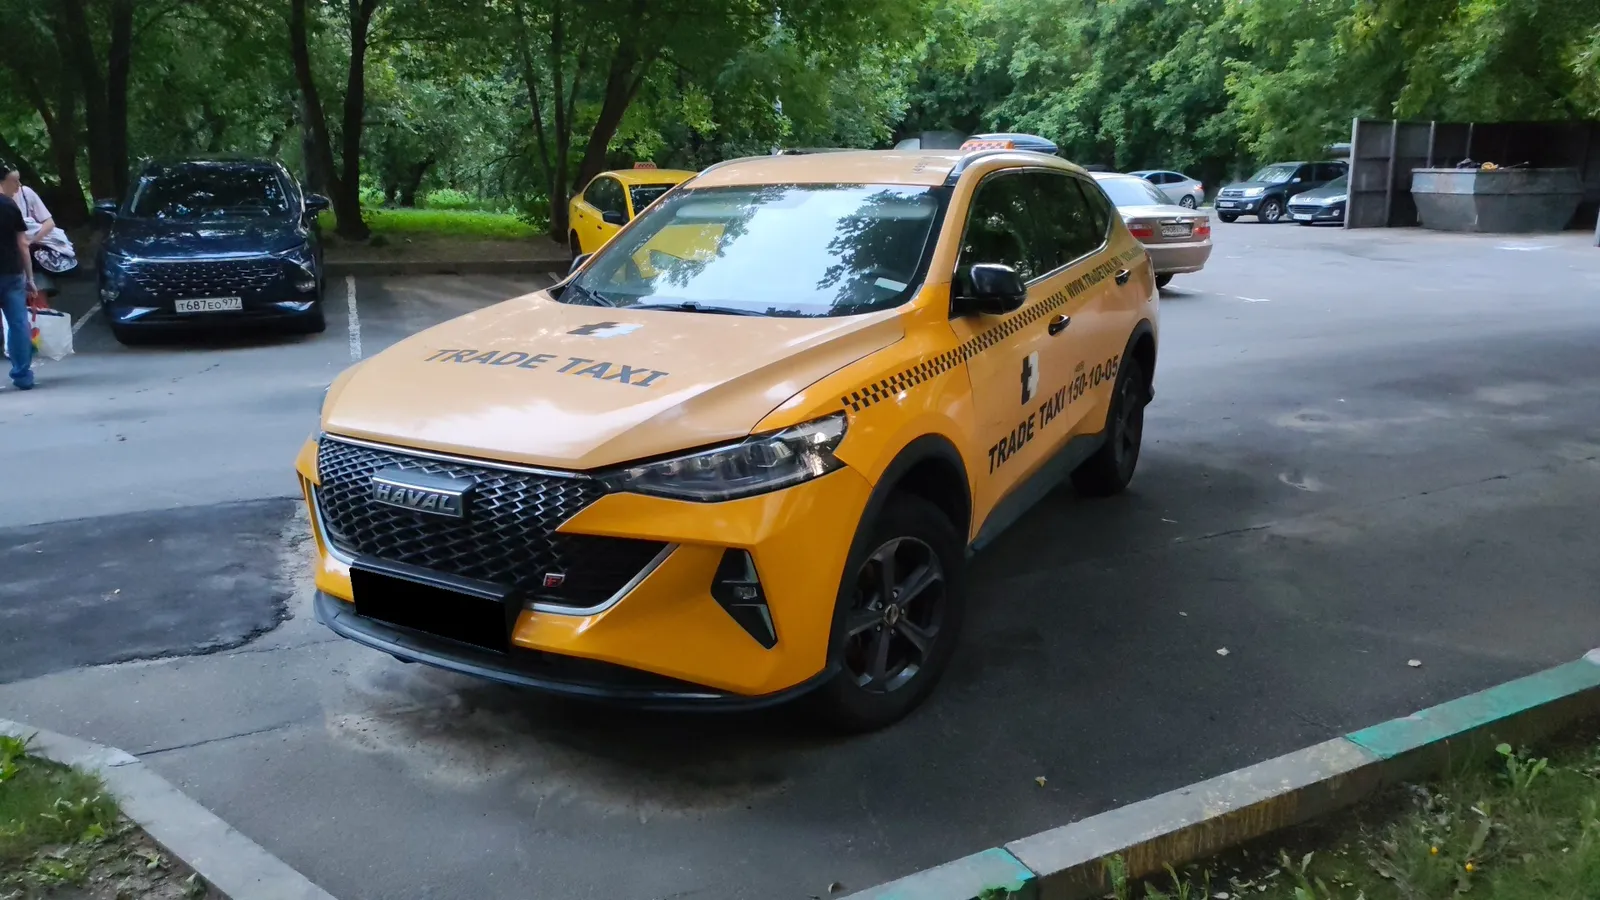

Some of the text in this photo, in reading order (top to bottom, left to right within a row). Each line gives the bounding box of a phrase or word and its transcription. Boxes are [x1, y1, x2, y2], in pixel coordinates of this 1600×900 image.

[424, 349, 669, 387] TRADE TAXI
[988, 412, 1035, 475] TRADE
[1039, 385, 1066, 430] TAXI
[377, 483, 455, 511] HAVAL
